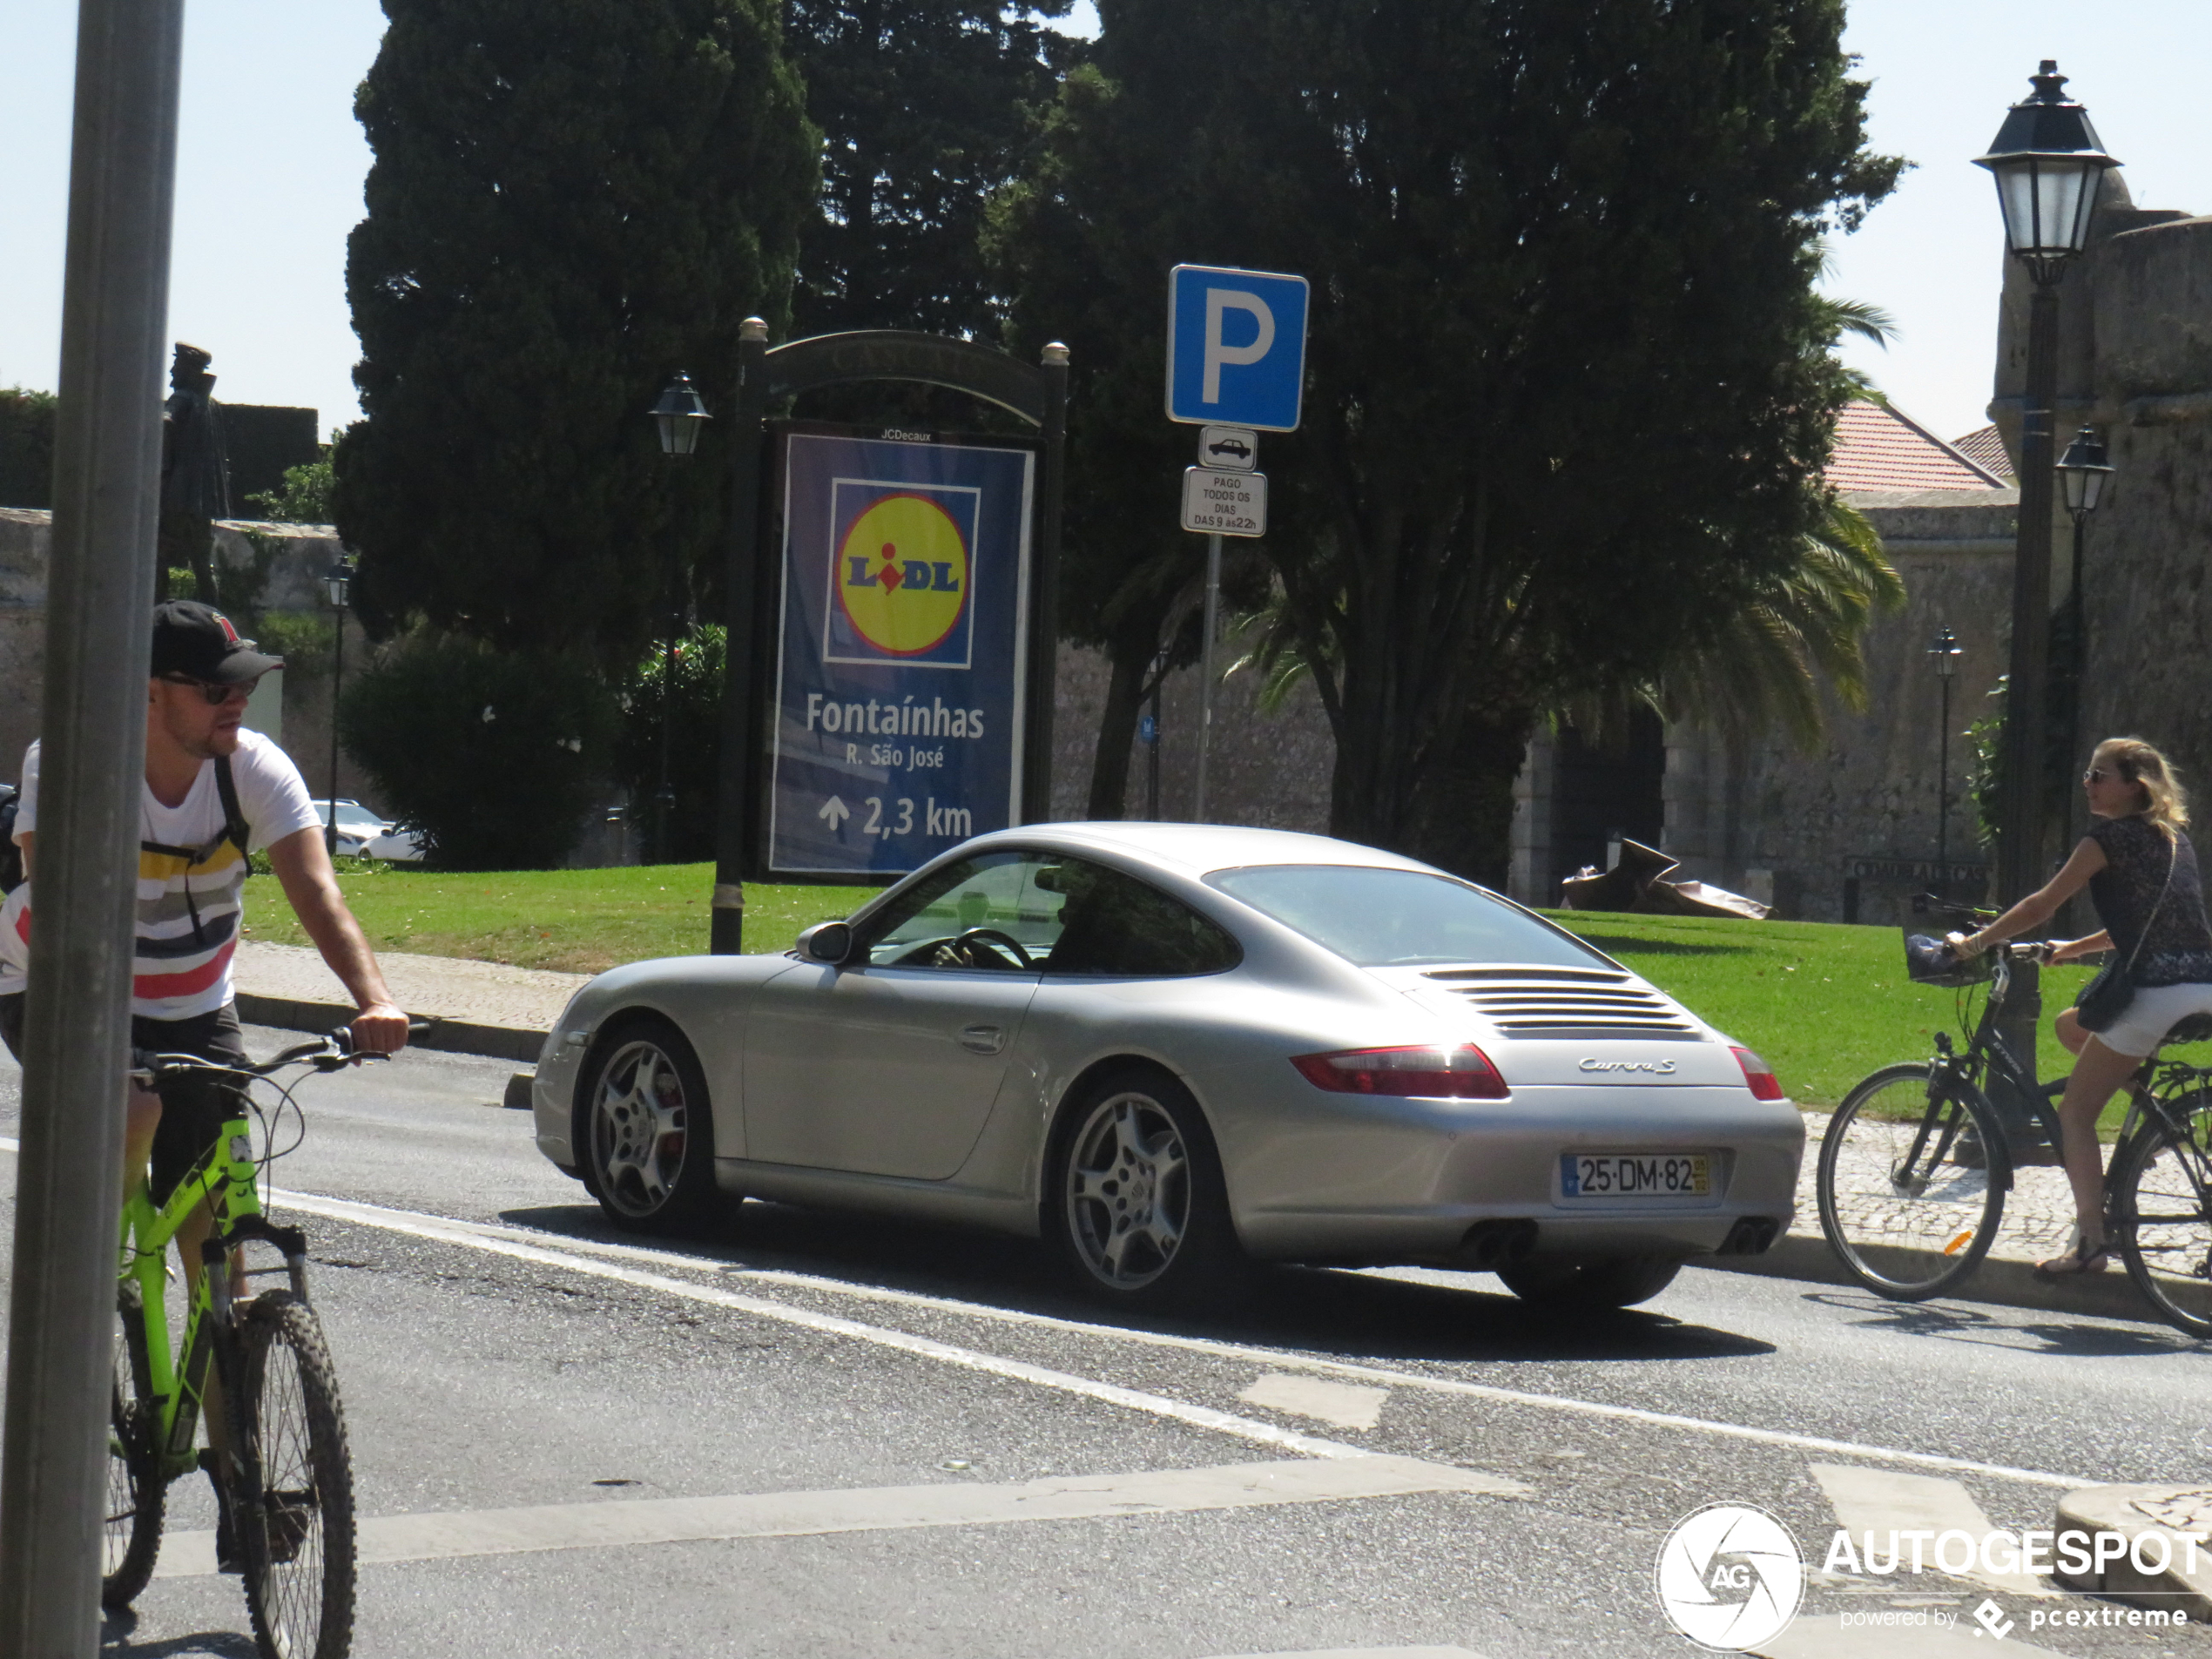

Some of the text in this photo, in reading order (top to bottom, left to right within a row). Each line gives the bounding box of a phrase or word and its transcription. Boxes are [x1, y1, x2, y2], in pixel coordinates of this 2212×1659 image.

[1202, 287, 1276, 404] P
[881, 428, 931, 442] JCDecaux
[1214, 476, 1241, 489] PAGO
[1204, 489, 1250, 502] TODOS OS
[1215, 503, 1236, 515] DIAS
[1194, 515, 1215, 525] DAS
[1217, 516, 1223, 527] 9
[807, 693, 984, 738] Fontaínhas
[846, 743, 944, 772] R. São José
[863, 797, 972, 840] 2,3 km
[1579, 1056, 1676, 1076] Carrera S
